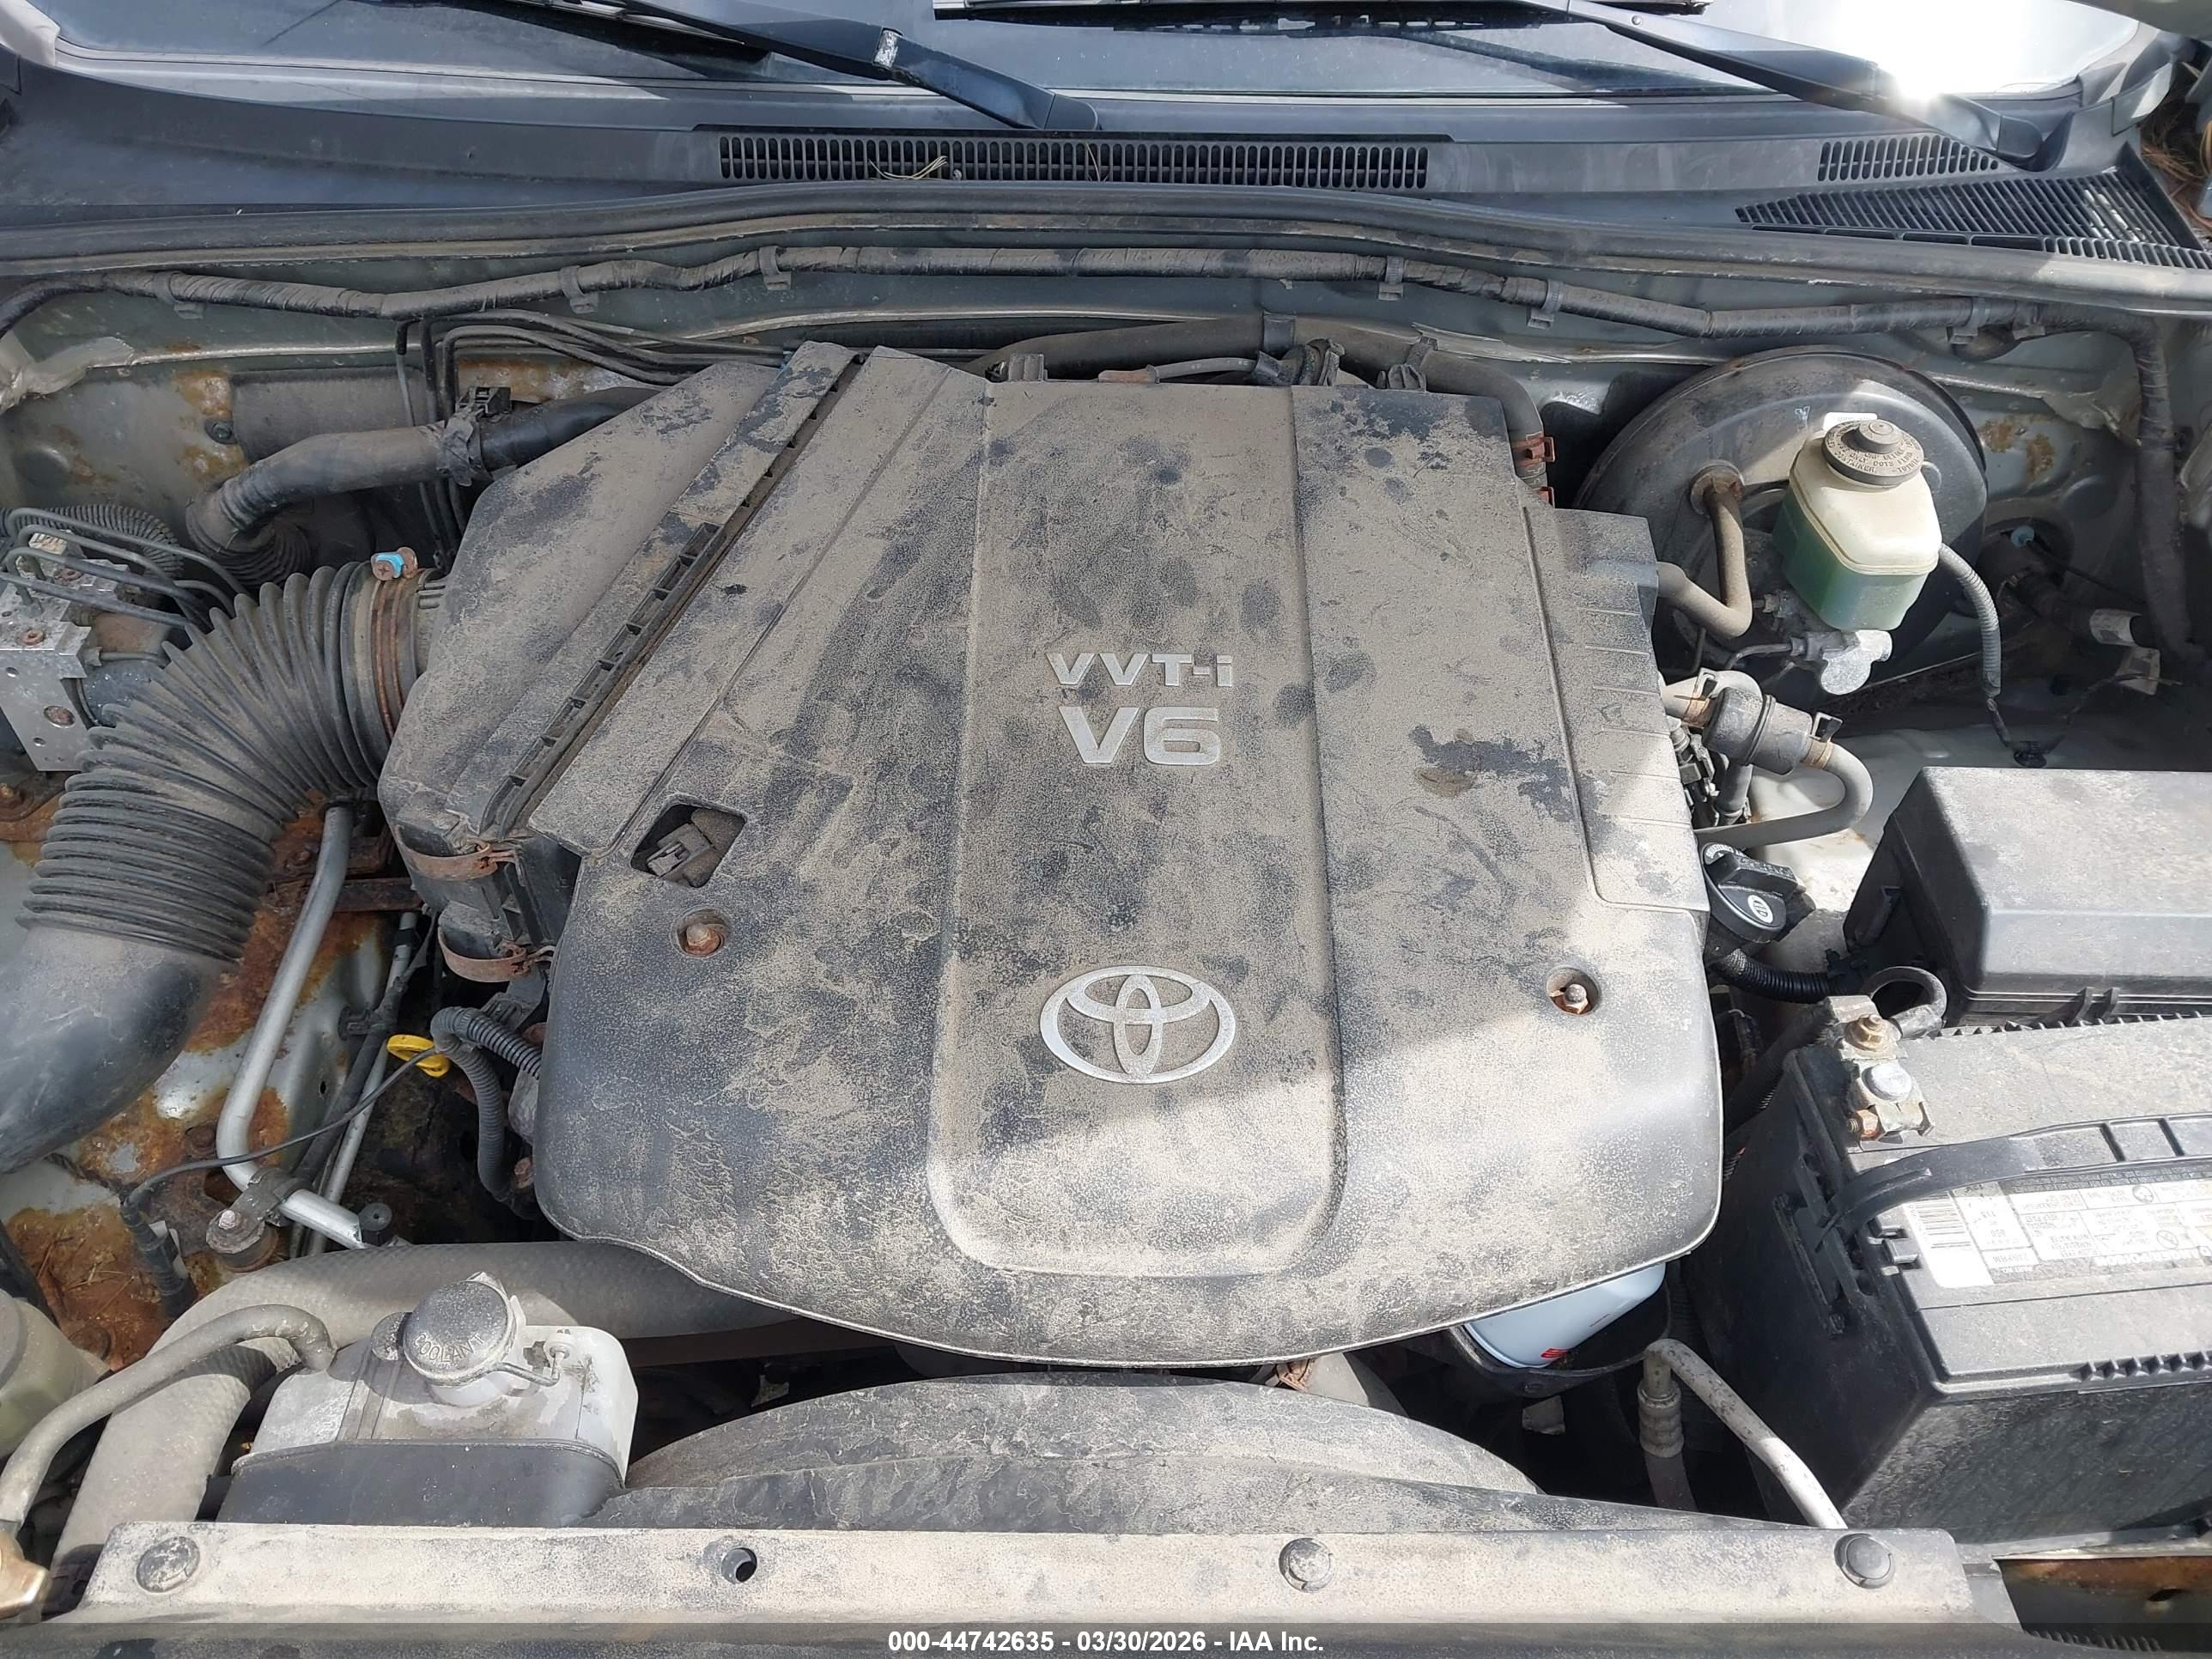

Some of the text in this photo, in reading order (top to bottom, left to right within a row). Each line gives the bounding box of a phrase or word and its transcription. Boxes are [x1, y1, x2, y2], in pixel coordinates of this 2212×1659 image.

[1045, 653, 1233, 687] VVT-i
[1058, 707, 1220, 766] V6
[414, 1332, 484, 1363] COOLANT
